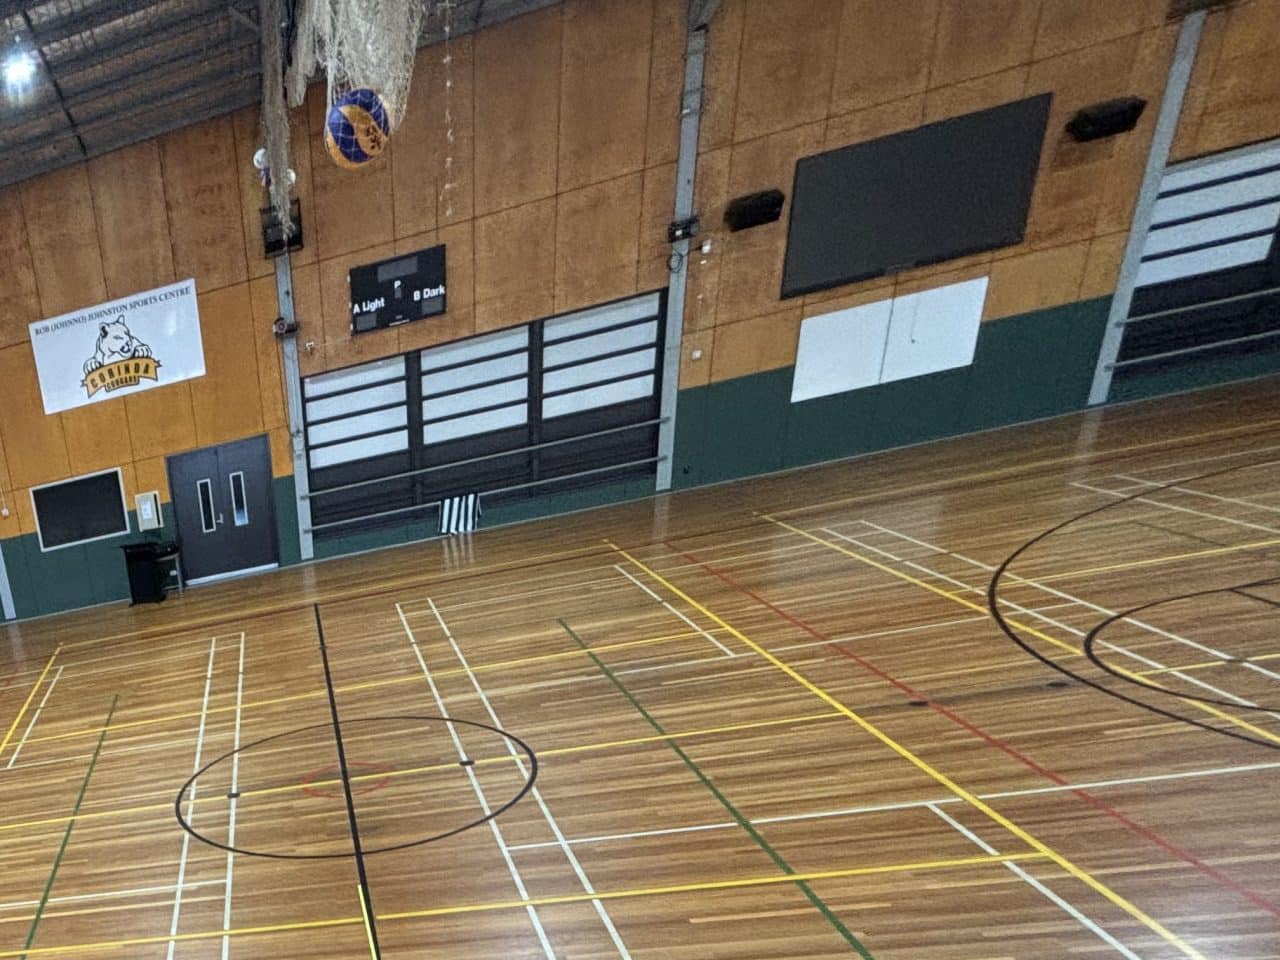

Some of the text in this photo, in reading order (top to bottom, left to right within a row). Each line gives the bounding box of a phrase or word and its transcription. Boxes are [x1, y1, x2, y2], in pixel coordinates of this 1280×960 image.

[413, 284, 446, 302] B Dark
[86, 304, 129, 324] JOHNSTON
[129, 295, 158, 312] SPORTS
[158, 286, 191, 303] CENTRE
[353, 296, 385, 314] A Light
[90, 362, 150, 389] CORINDA
